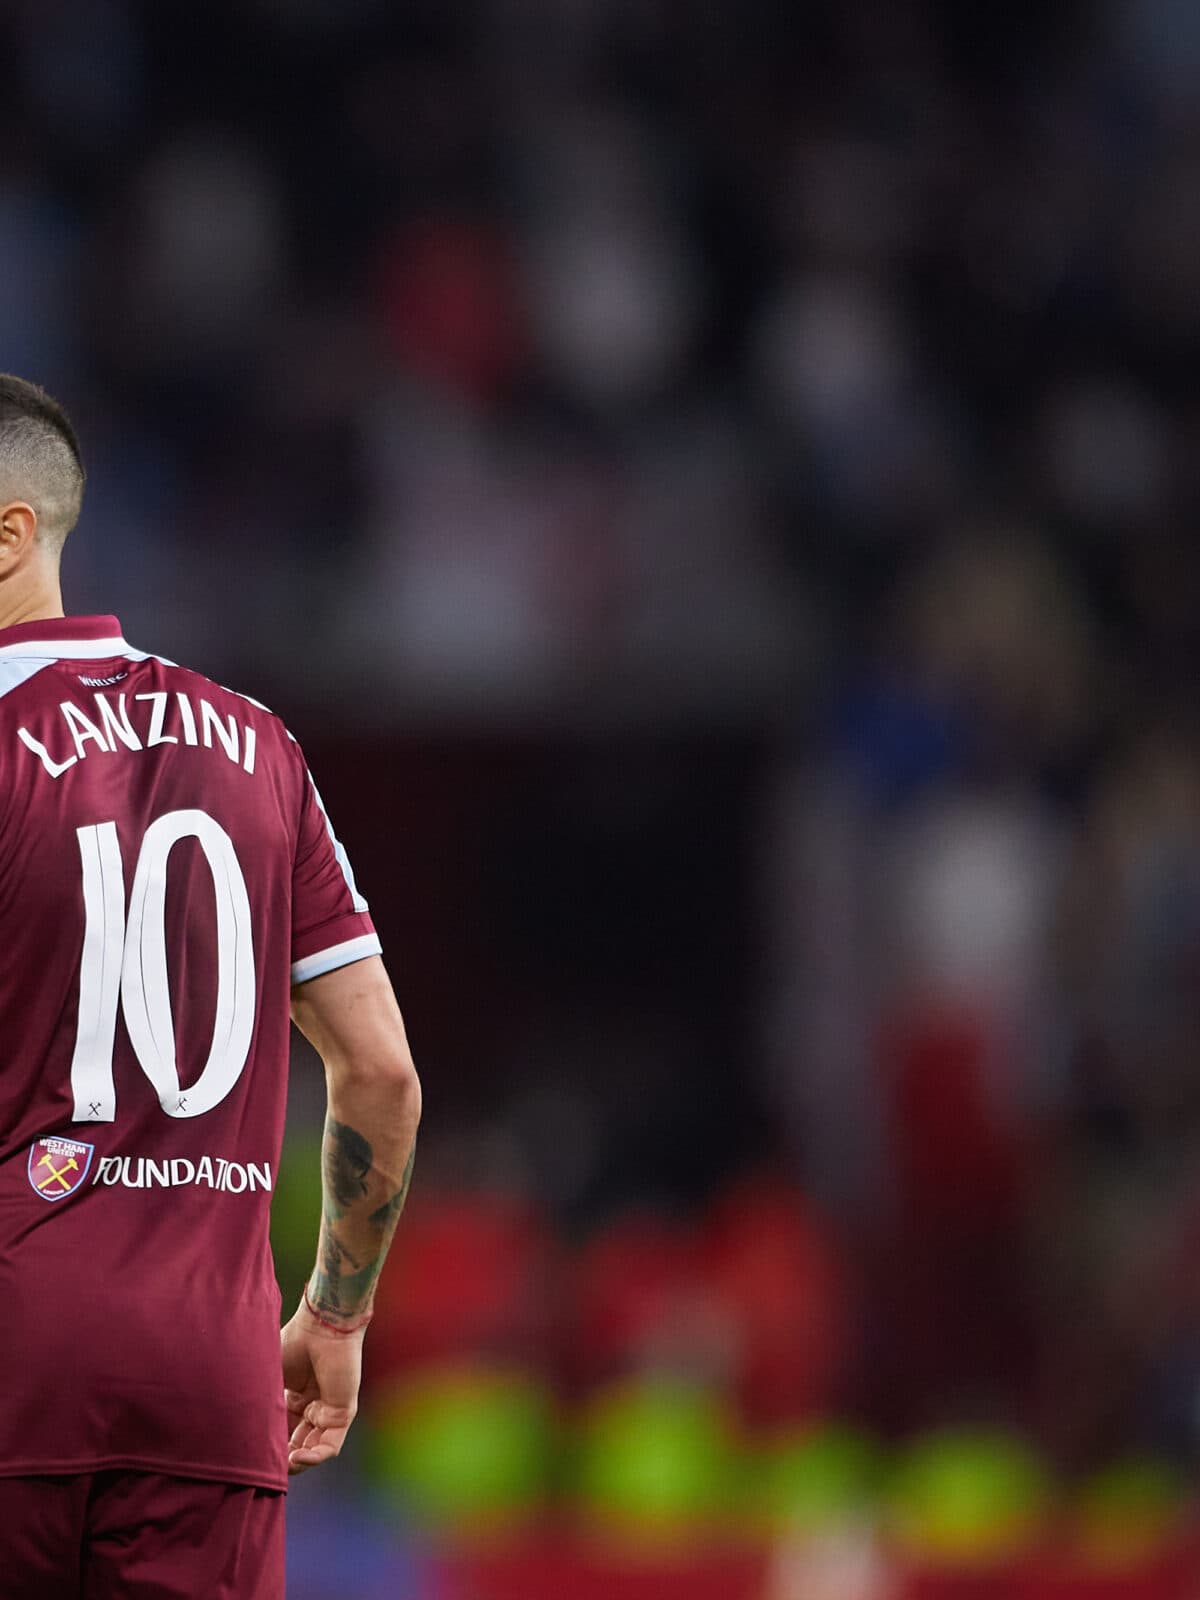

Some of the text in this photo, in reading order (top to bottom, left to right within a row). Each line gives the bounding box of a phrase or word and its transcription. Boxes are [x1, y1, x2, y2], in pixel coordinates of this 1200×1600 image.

[17, 692, 256, 778] LANZINI
[71, 809, 256, 1122] 10
[39, 1138, 86, 1154] WEST HAM
[92, 1156, 272, 1193] FOUNDATION
